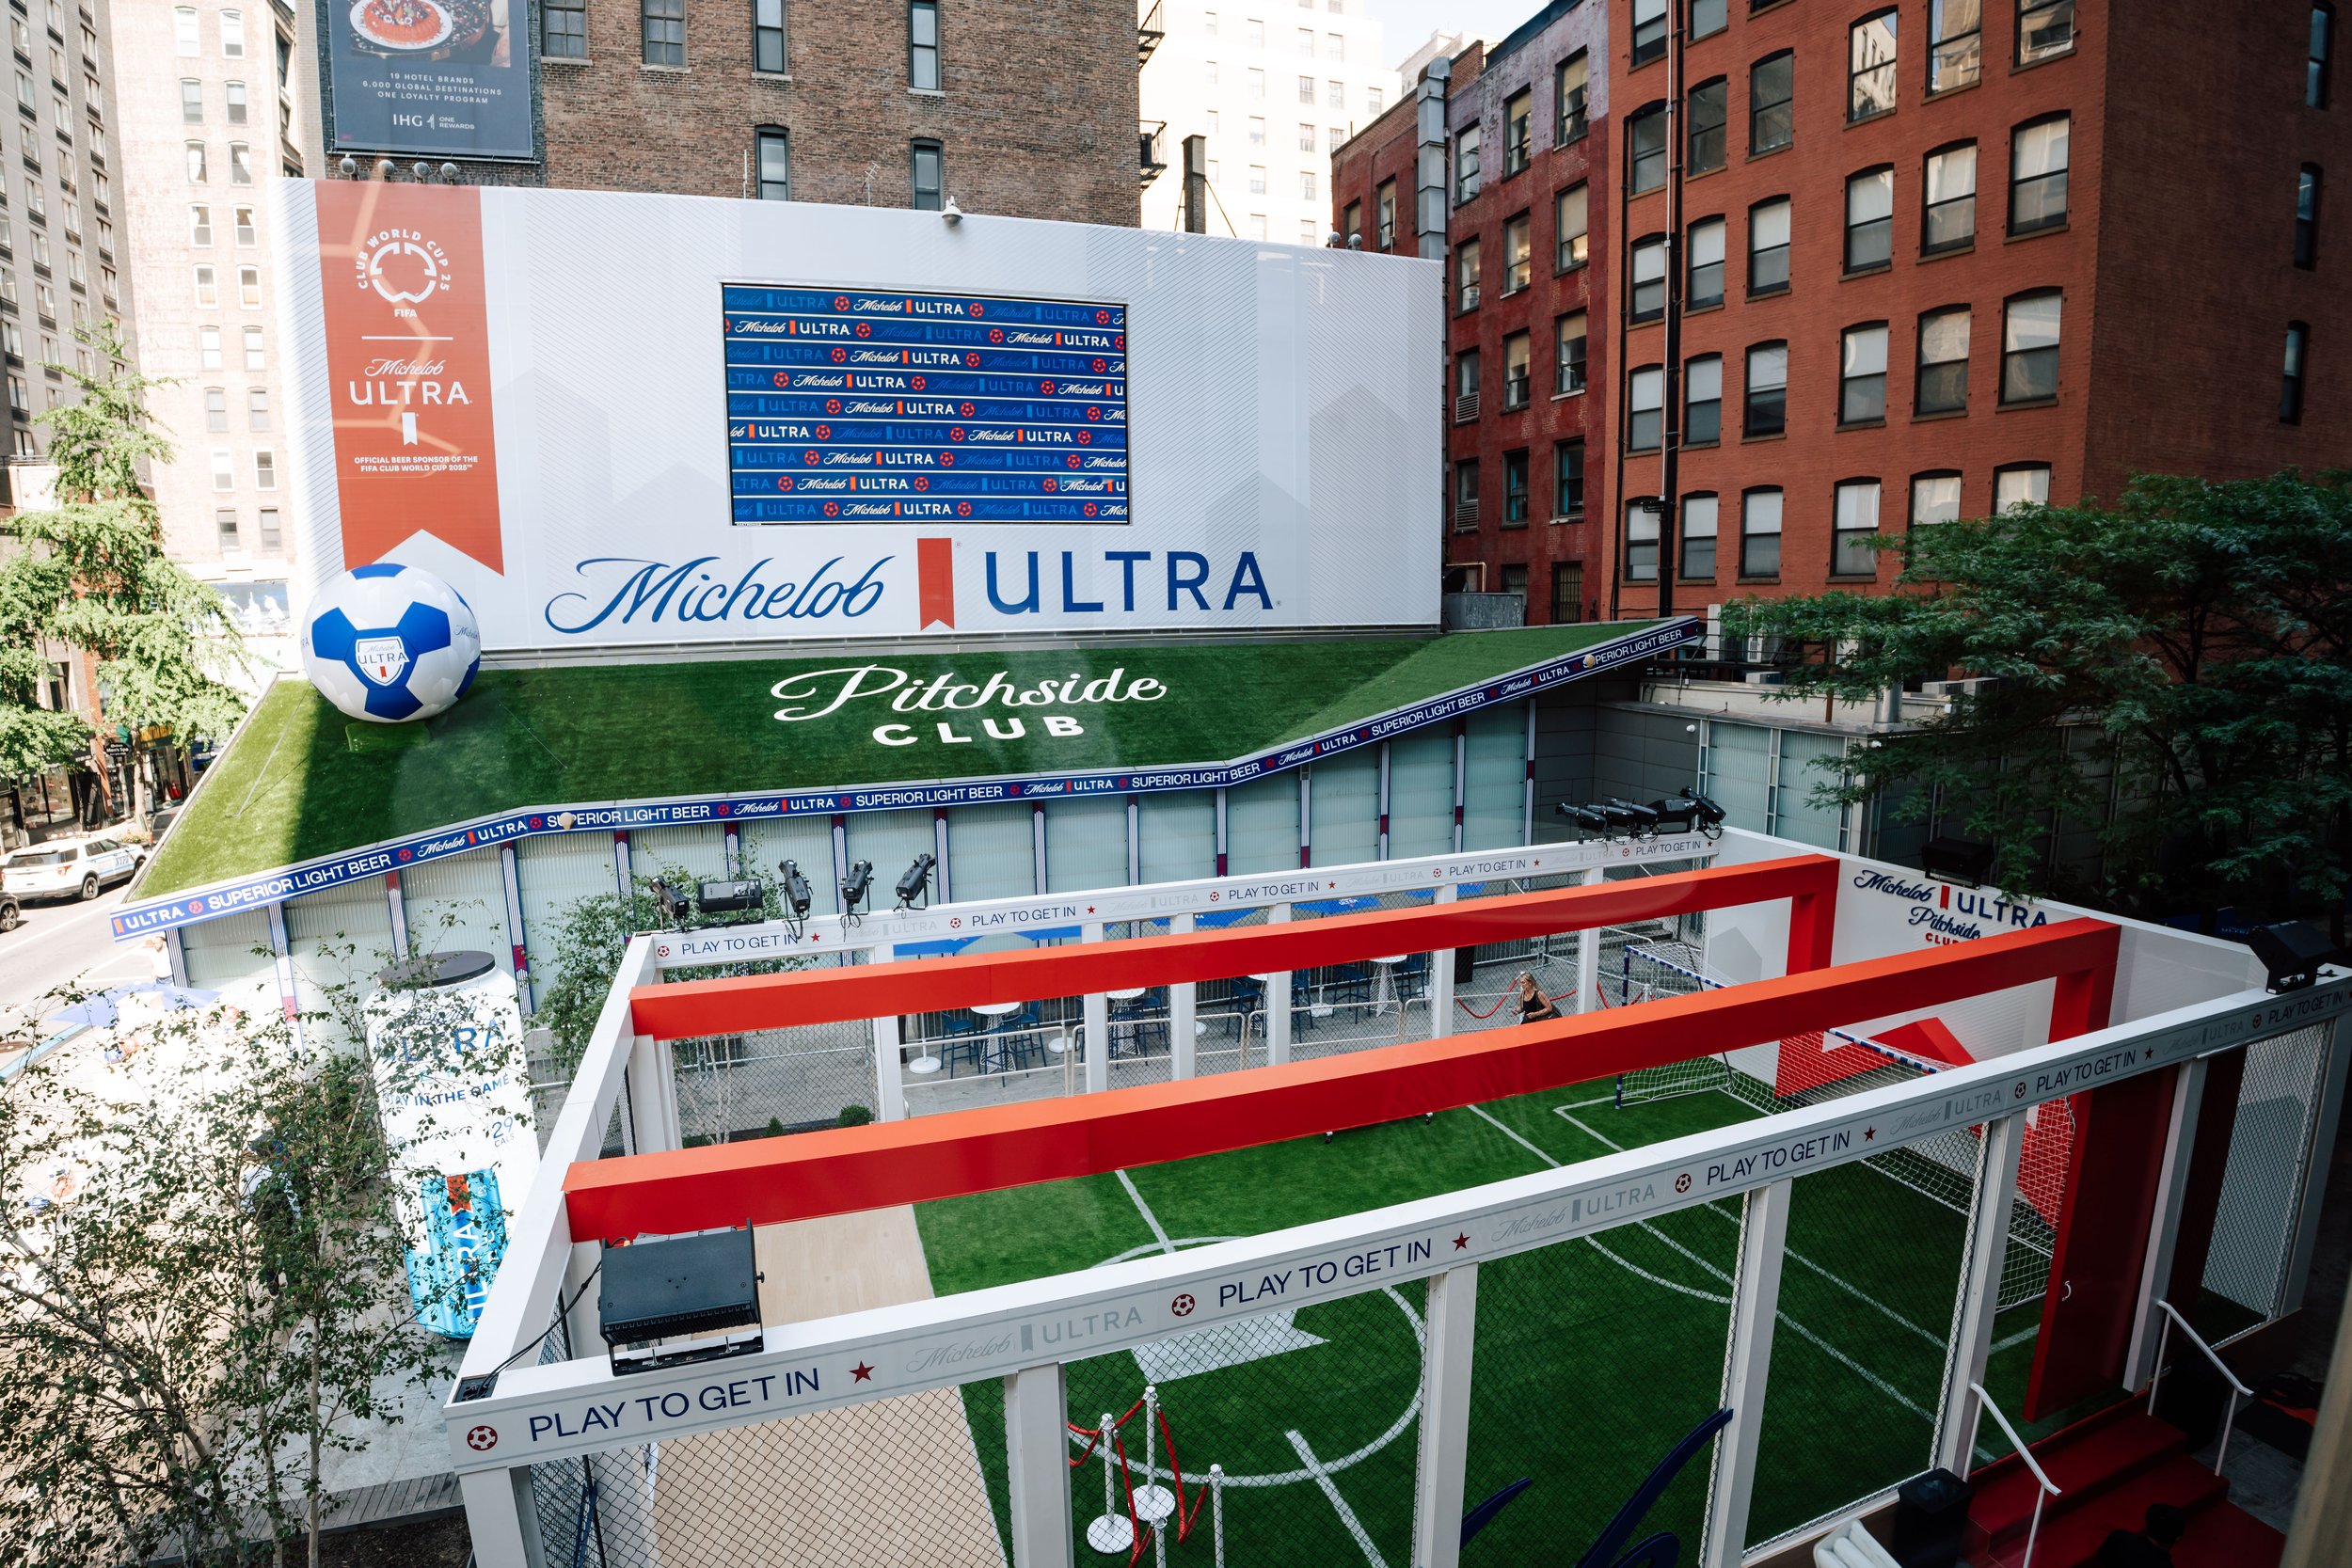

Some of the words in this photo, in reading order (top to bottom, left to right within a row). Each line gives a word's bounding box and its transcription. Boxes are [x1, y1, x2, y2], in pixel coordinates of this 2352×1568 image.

[395, 83, 431, 91] GLOBAL
[436, 85, 501, 95] DESTINATIONS
[438, 75, 473, 84] BRANDS
[401, 92, 439, 102] LOYALTY
[444, 95, 487, 103] PROGRAM
[393, 114, 422, 127] IHG
[356, 251, 369, 289] CLUB
[367, 229, 421, 248] WORLD
[427, 241, 448, 267] CUP
[440, 274, 451, 291] 25
[394, 309, 417, 317] FIFA
[853, 299, 903, 312] Michelob
[915, 301, 963, 315] ULTRA
[735, 321, 786, 333] Michelob
[800, 323, 850, 335] ULTRA
[1007, 332, 1053, 344] Michelob
[1065, 335, 1109, 347] ULTRA
[365, 359, 446, 376] Michelob
[850, 350, 899, 363] Michelob
[913, 352, 961, 365] ULTRA
[350, 381, 469, 404] ULTRA
[793, 374, 843, 387] Michelob
[856, 376, 906, 388] ULTRA
[1058, 383, 1102, 395] Michelob
[845, 402, 894, 414] Michelob
[907, 403, 956, 415] ULTRA
[1037, 407, 1080, 419] ULTRA
[759, 426, 810, 437] ULTRA
[968, 430, 1014, 441] Michelob
[1027, 431, 1073, 443] ULTRA
[824, 452, 872, 465] Michelob
[886, 453, 933, 465] ULTRA
[1016, 455, 1060, 467] ULTRA
[798, 478, 846, 490] Michelob
[860, 479, 909, 490] ULTRA
[992, 480, 1036, 490] ULTRA
[1060, 481, 1104, 492] Michelob
[843, 503, 891, 515] Michelob
[904, 504, 952, 515] ULTRA
[1033, 504, 1077, 515] ULTRA
[545, 556, 897, 634] Michelob
[985, 551, 1273, 616] ULTRA
[358, 652, 406, 665] ULTRA
[1582, 646, 1629, 669] SPERIOR
[1630, 637, 1657, 653] LIGHT
[1659, 629, 1681, 644] BEER
[1502, 678, 1531, 694] Michelob
[1539, 666, 1569, 682] ULTRA
[771, 664, 1167, 722] Pitchside
[1372, 712, 1423, 736] SUPERIOR
[1425, 701, 1456, 719] LIGHT
[1458, 692, 1485, 708] BEER
[872, 716, 1084, 746] CLUB
[1279, 747, 1312, 766] Michelob
[1322, 734, 1357, 751] ULTRA
[1132, 774, 1191, 787] SUPERIOR
[1193, 771, 1227, 784] LIGHT
[1231, 763, 1260, 780] BEER
[856, 791, 923, 806] SUPERIOR
[927, 788, 965, 801] LIGHT
[969, 786, 1002, 799] BEER
[1024, 782, 1063, 795] Michelob
[1074, 779, 1113, 791] ULTRA
[625, 808, 669, 822] LIGHT
[673, 805, 709, 818] BEER
[734, 801, 778, 815] Michelob
[791, 799, 834, 810] ULTRA
[418, 837, 465, 857] Michelob
[478, 820, 527, 841] ULTRA
[1636, 845, 1658, 856] PLAY
[1660, 844, 1672, 853] TO
[1673, 842, 1692, 852] GET
[1692, 841, 1701, 849] IN
[1449, 864, 1475, 877] PLAY
[1479, 863, 1491, 874] TO
[1493, 861, 1514, 873] GET
[1516, 859, 1525, 870] IN
[209, 879, 294, 910] SUPERIOR
[294, 864, 343, 888] LIGHT
[351, 854, 390, 875] BEER
[1230, 888, 1259, 900] PLAY
[1262, 885, 1278, 896] TO
[1280, 883, 1305, 895] GET
[1308, 881, 1319, 893] IN
[1853, 870, 1935, 902] Michelob
[1958, 893, 2047, 928] ULTRA
[127, 908, 184, 929] ULTRA
[973, 912, 1006, 927] PLAY
[1010, 911, 1028, 923] TO
[1032, 908, 1060, 920] GET
[1064, 906, 1075, 917] IN
[1909, 906, 1980, 940] Pitchside
[682, 941, 720, 955] PLAY
[723, 938, 745, 950] TO
[749, 935, 780, 948] GET
[785, 933, 799, 944] IN
[2268, 1006, 2294, 1024] PLAY
[2295, 999, 2310, 1016] TO
[2312, 994, 2332, 1011] GET
[2333, 990, 2344, 1003] IN
[2036, 1069, 2072, 1093] PLAY
[2074, 1061, 2092, 1083] TO
[2095, 1054, 2122, 1077] GET
[2123, 1049, 2137, 1067] IN
[415, 1096, 430, 1106] IN
[436, 1090, 466, 1103] THE
[1890, 1109, 1941, 1135] Michelob
[1955, 1089, 2001, 1117] ULTRA
[492, 1117, 513, 1139] 29
[1707, 1153, 1758, 1186] PLAY
[1762, 1148, 1787, 1171] TO
[1791, 1135, 1831, 1163] GET
[1834, 1130, 1850, 1151] IN
[1491, 1206, 1567, 1243] Michelob
[1587, 1184, 1655, 1217] ULTRA
[1219, 1271, 1292, 1307] PLAY
[1299, 1261, 1338, 1288] TO
[1344, 1244, 1401, 1277] GET
[1407, 1238, 1431, 1264] IN
[906, 1330, 1014, 1373] Michelob
[1043, 1306, 1142, 1345] ULTRA
[530, 1402, 626, 1443] PLAY
[635, 1391, 689, 1422] TO
[699, 1375, 776, 1409] GET
[786, 1367, 820, 1397] IN
